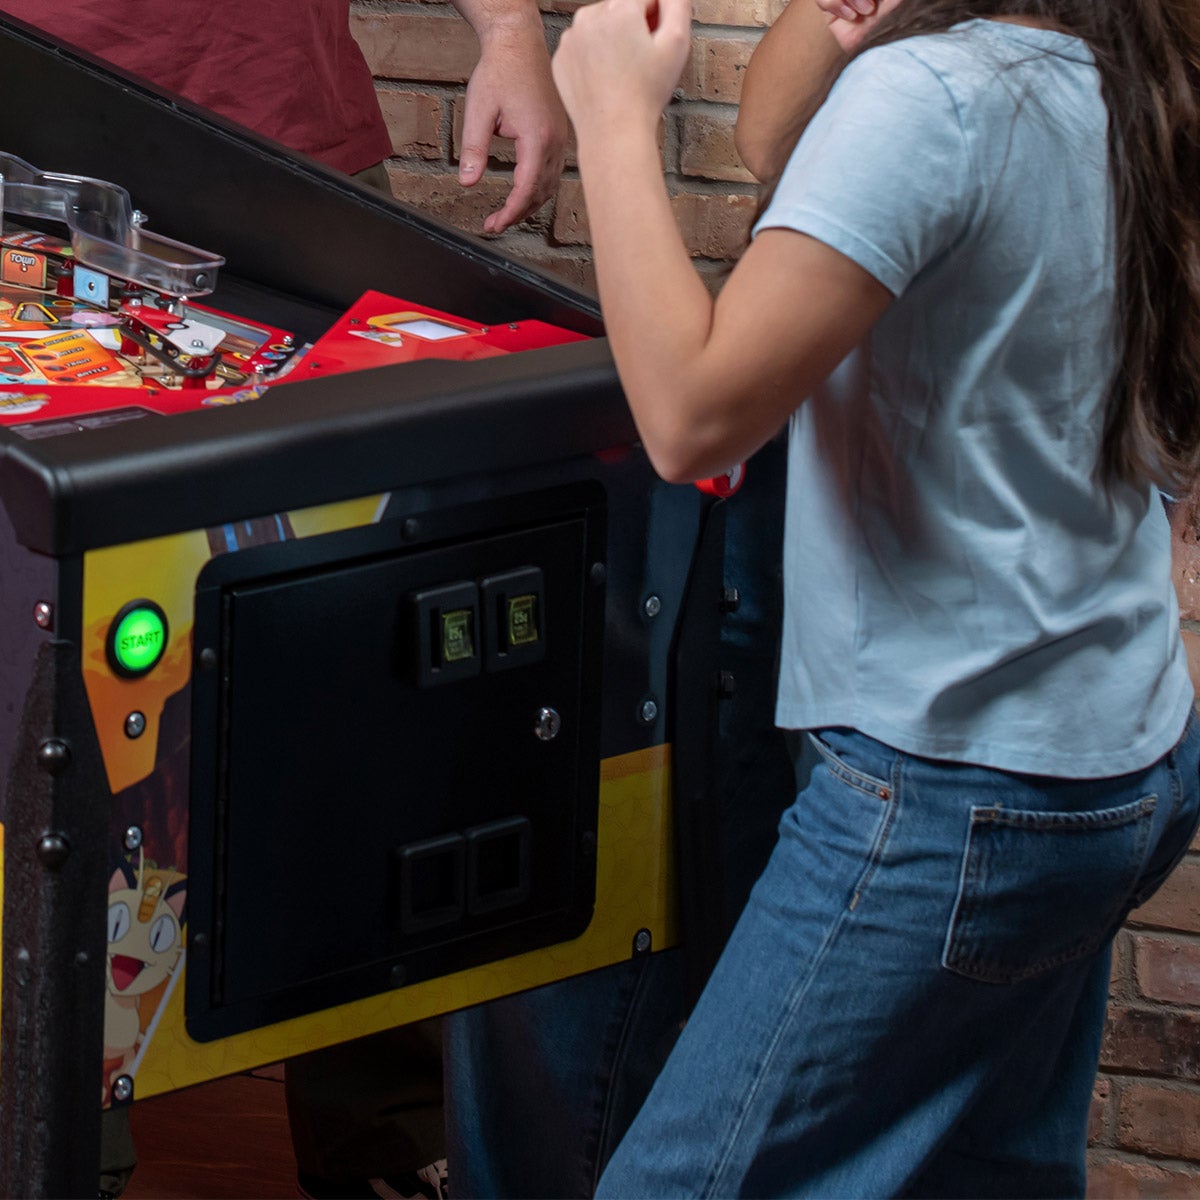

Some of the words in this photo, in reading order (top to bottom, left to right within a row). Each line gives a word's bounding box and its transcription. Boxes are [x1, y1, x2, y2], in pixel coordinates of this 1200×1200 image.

[10, 253, 35, 265] TOWN
[76, 366, 108, 378] BATTLE
[121, 630, 160, 650] START
